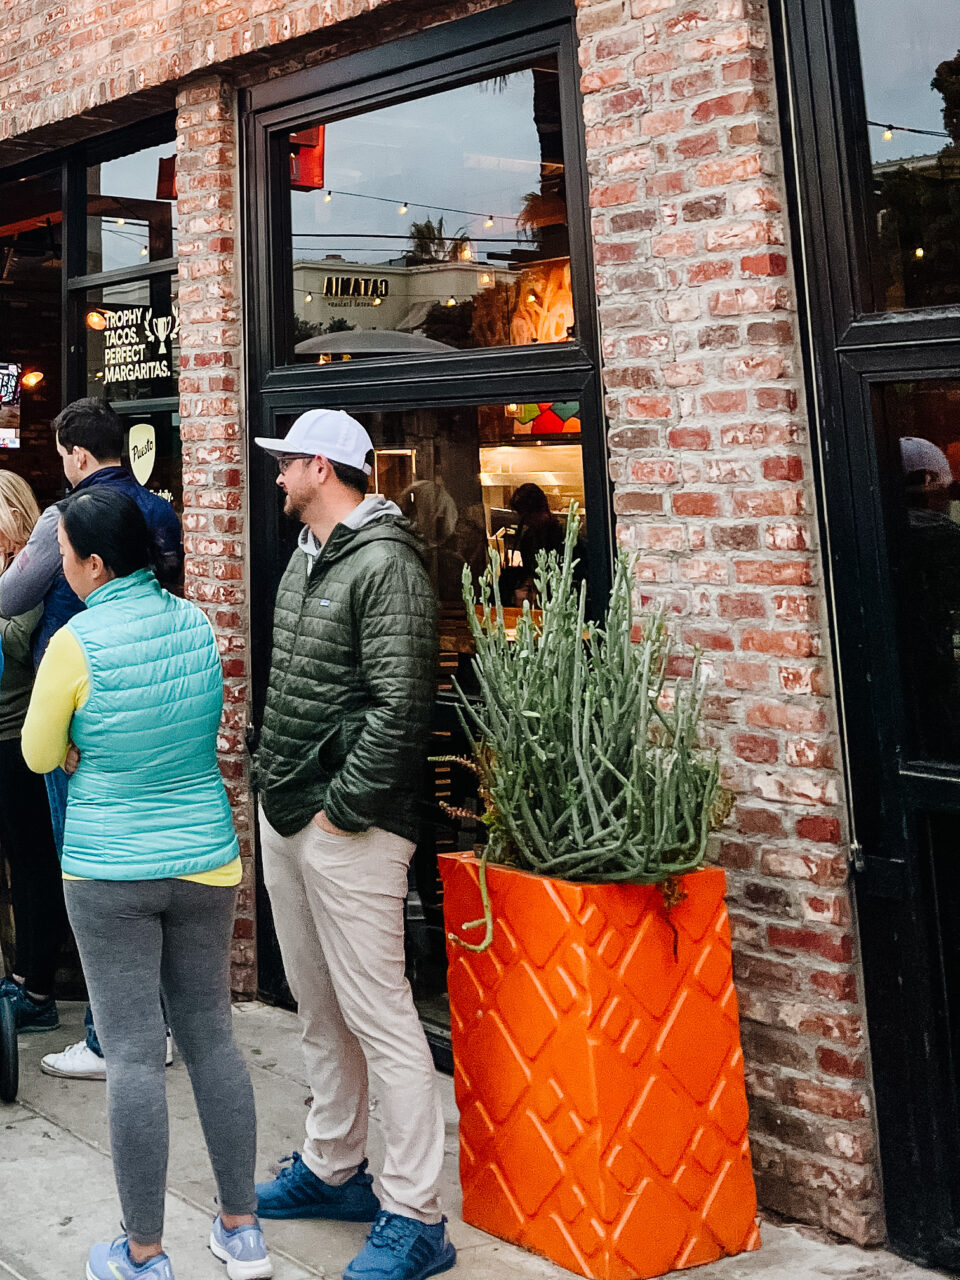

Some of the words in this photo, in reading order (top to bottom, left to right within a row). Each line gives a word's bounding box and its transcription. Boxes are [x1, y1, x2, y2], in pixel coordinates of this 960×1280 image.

[104, 308, 143, 329] TROPHY
[104, 327, 140, 346] TACOS.
[104, 344, 146, 365] PERFECT
[103, 360, 171, 383] MARGARITAS.
[132, 438, 154, 463] Puesto
